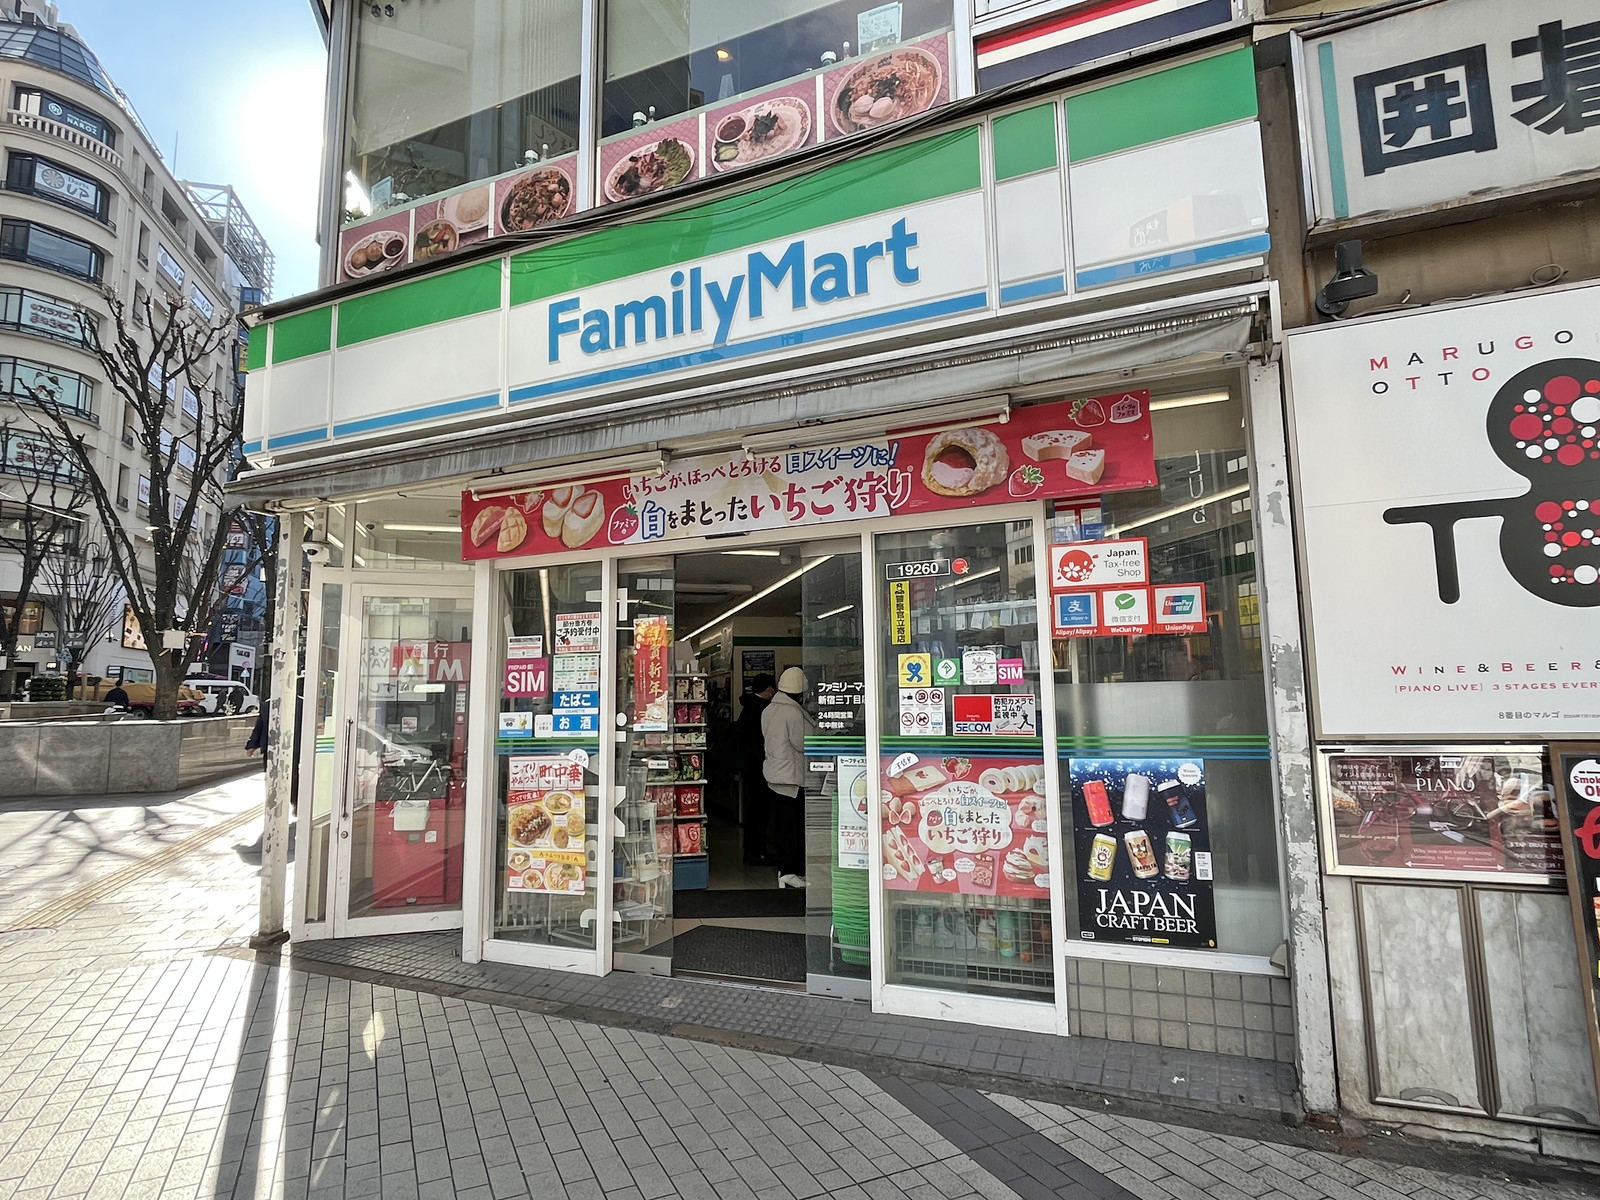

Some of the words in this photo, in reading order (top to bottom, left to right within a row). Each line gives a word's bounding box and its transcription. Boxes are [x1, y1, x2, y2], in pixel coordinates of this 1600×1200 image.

[548, 216, 920, 364] FamilyMart
[1369, 329, 1574, 371] MARUGO
[1372, 367, 1491, 395] OTTO
[612, 518, 638, 530] ファミマ
[1106, 549, 1140, 559] Japan.
[897, 562, 939, 577] 19260
[1103, 558, 1141, 569] Tax-free
[1117, 568, 1141, 578] Shop
[1111, 615, 1141, 623] 微信支付
[556, 627, 600, 637] ご予約受付中
[1131, 627, 1143, 635] Pay
[1164, 624, 1194, 632] UnionPay
[399, 658, 464, 681] ATM
[999, 667, 1023, 680] SIM
[507, 670, 545, 693] SIM
[818, 682, 866, 692] ファミリーマ
[1505, 682, 1557, 690] STAGES
[560, 693, 592, 707] たばこ
[818, 711, 854, 719] 24時間営業
[1498, 711, 1561, 720] 8番目のマルゴ
[955, 723, 991, 732] SECOM
[512, 762, 536, 776] こってり
[539, 762, 583, 785] 町中華
[1415, 777, 1476, 792] PIANO
[927, 826, 1002, 847] いちご狩り
[1095, 888, 1197, 920] JAPAN
[1096, 913, 1151, 930] CRAFT
[1153, 916, 1200, 935] BEER
